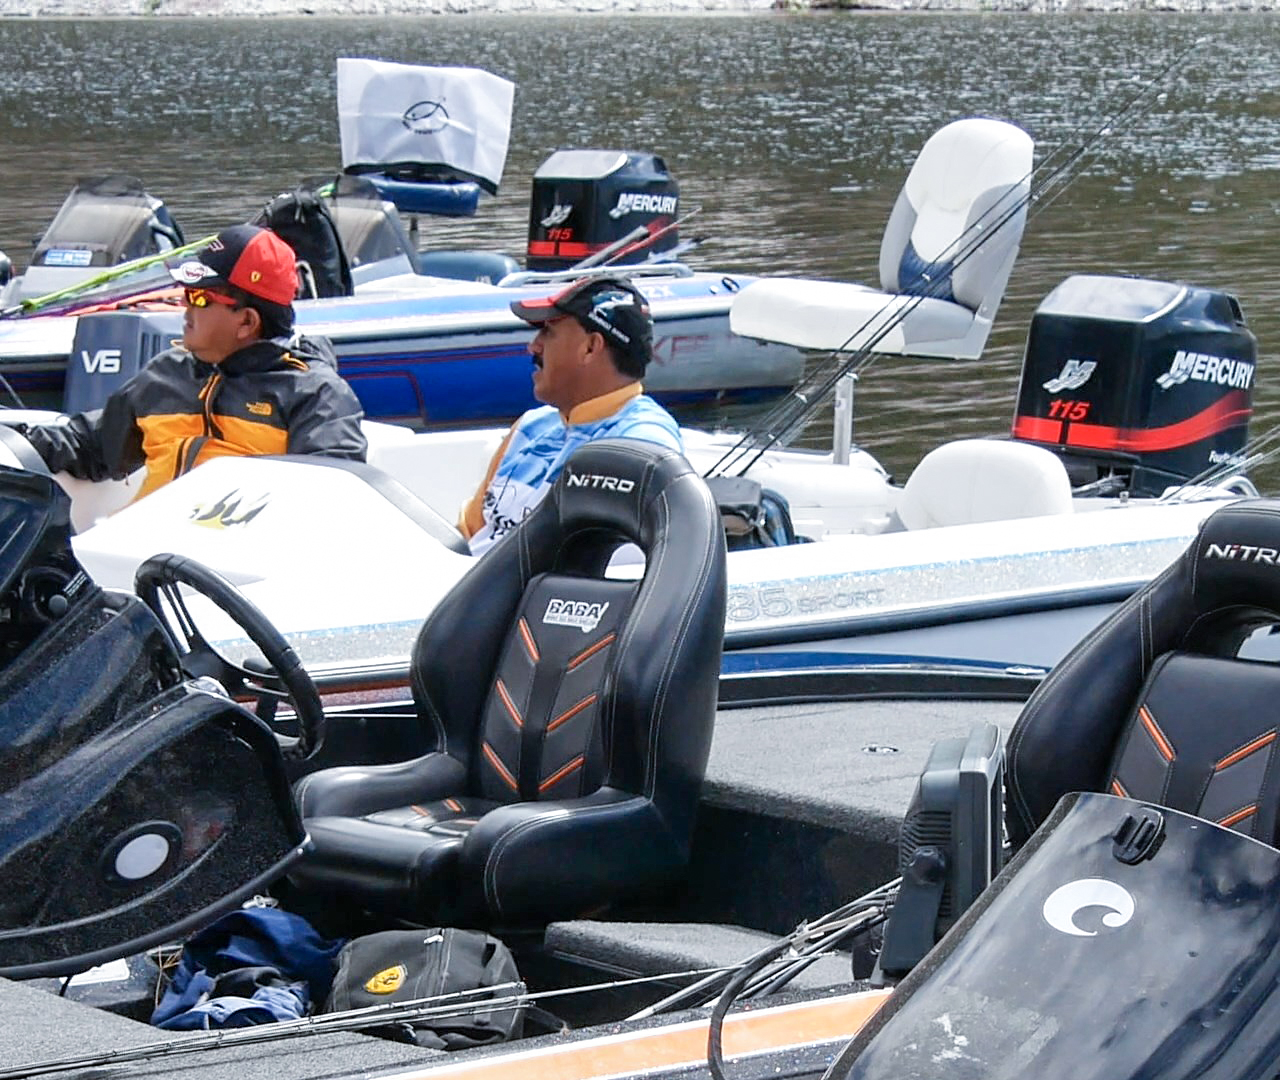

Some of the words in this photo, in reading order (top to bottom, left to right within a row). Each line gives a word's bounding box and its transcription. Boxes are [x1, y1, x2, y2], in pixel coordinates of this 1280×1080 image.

[609, 193, 678, 218] MERCURY
[547, 228, 574, 240] 115
[81, 349, 122, 374] V6
[1156, 350, 1255, 389] MERCURY
[1047, 399, 1091, 420] 115
